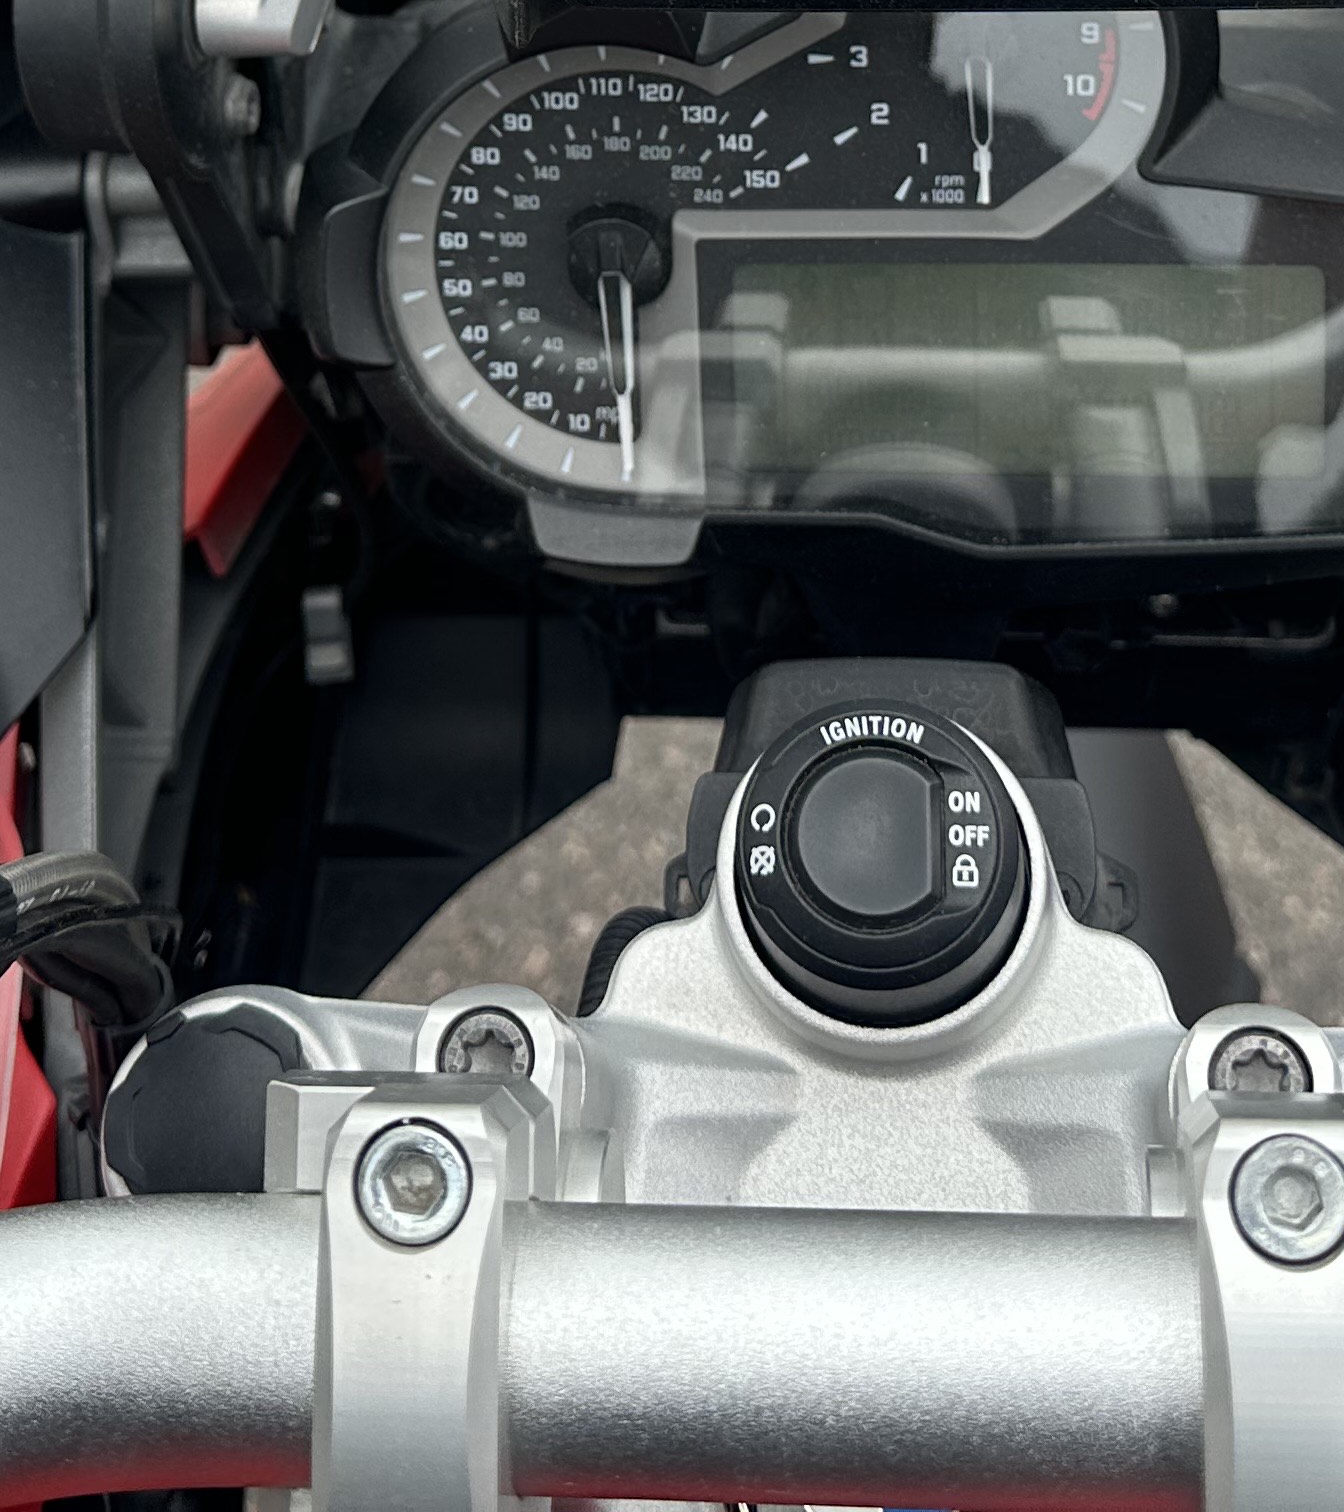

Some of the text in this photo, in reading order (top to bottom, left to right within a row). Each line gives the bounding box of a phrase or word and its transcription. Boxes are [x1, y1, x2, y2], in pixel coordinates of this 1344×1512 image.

[1081, 21, 1100, 44] 9
[849, 45, 869, 68] 3
[590, 77, 622, 96] 110
[637, 83, 674, 102] 120
[1063, 74, 1096, 97] 10
[542, 91, 579, 110] 100
[503, 113, 533, 132] 90
[681, 105, 717, 124] 130
[870, 102, 891, 125] 2
[603, 136, 631, 152] 180
[717, 133, 753, 152] 140
[470, 147, 500, 165] 80
[564, 144, 592, 160] 160
[639, 145, 672, 161] 200
[917, 142, 928, 165] 1
[533, 166, 560, 181] 140
[670, 165, 703, 181] 220
[744, 170, 780, 188] 150
[934, 175, 965, 188] rpm
[450, 186, 479, 204] 70
[513, 195, 540, 210] 120
[693, 188, 723, 204] 240
[439, 232, 468, 249] 60
[499, 232, 527, 248] 100
[442, 279, 472, 297] 50
[502, 272, 525, 287] 80
[517, 308, 540, 323] 60
[461, 325, 489, 343] 40
[541, 337, 564, 352] 40
[488, 361, 518, 380] 30
[575, 357, 598, 372] 20
[523, 392, 553, 410] 20
[568, 413, 590, 432] 10
[595, 406, 619, 425] mp
[820, 715, 924, 745] IGNITION
[948, 791, 980, 813] ON
[948, 825, 990, 847] OFF
